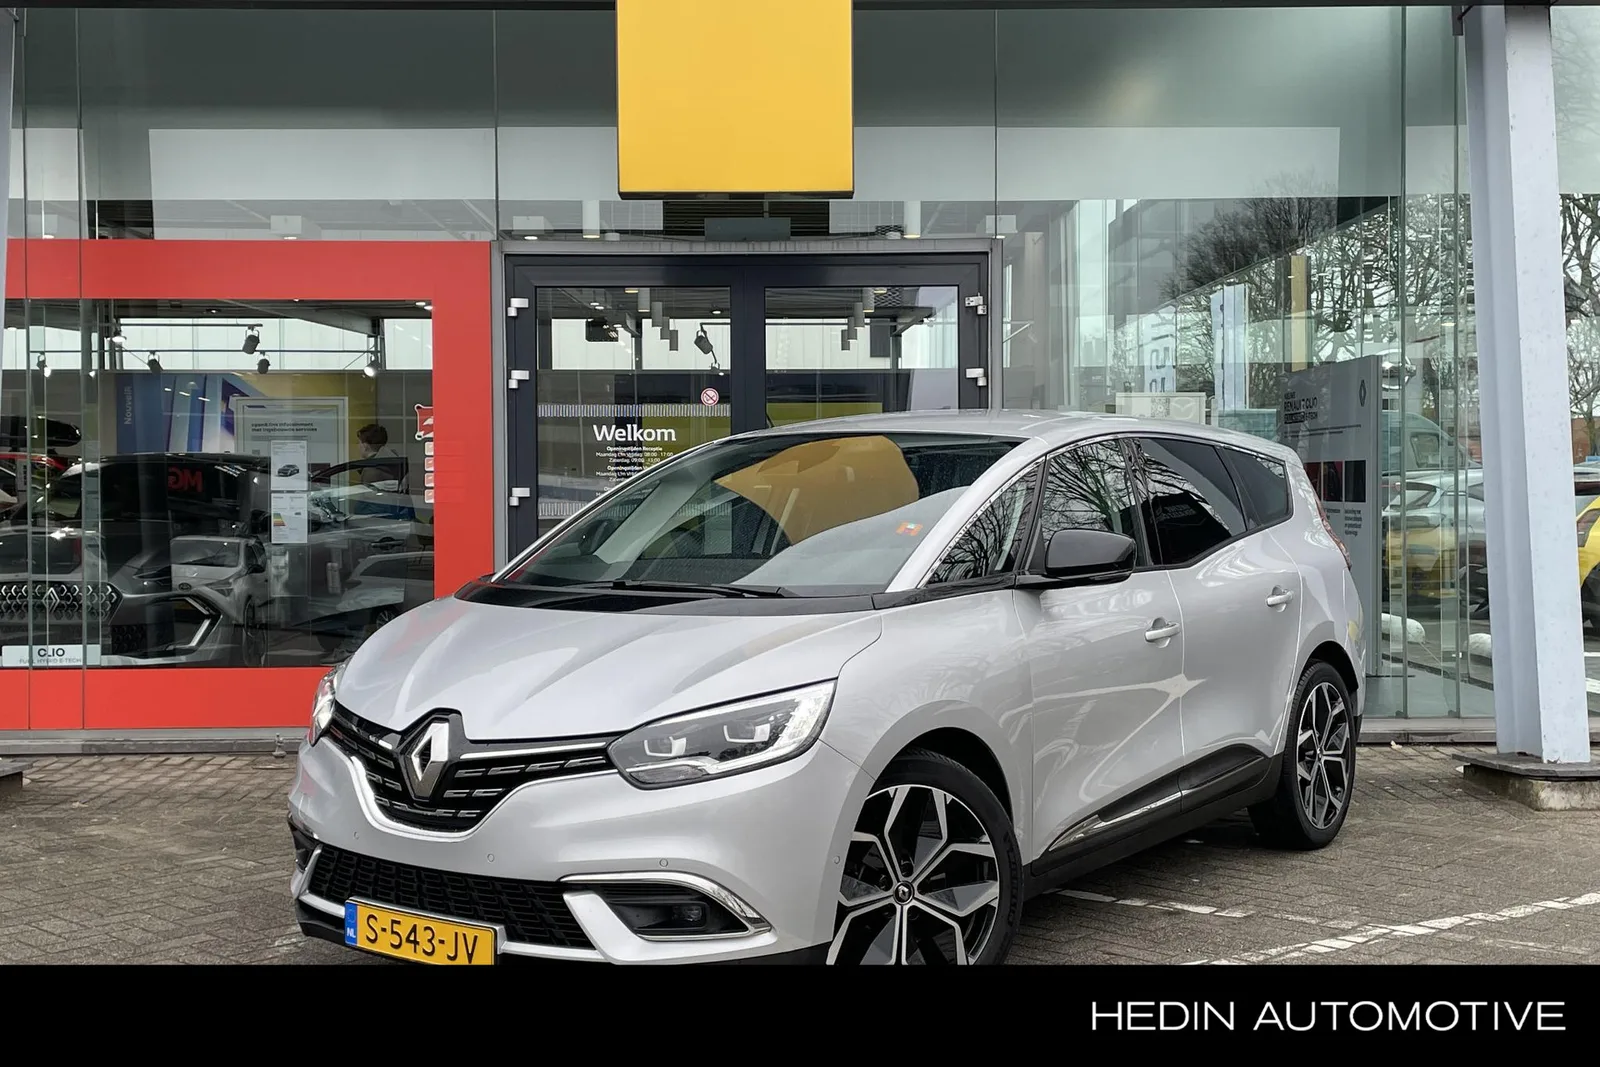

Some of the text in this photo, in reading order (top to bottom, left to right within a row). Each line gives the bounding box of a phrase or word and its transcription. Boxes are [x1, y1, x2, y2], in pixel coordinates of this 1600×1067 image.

[592, 423, 676, 441] Welkom
[346, 927, 356, 939] NL
[365, 913, 479, 964] S-543-JV
